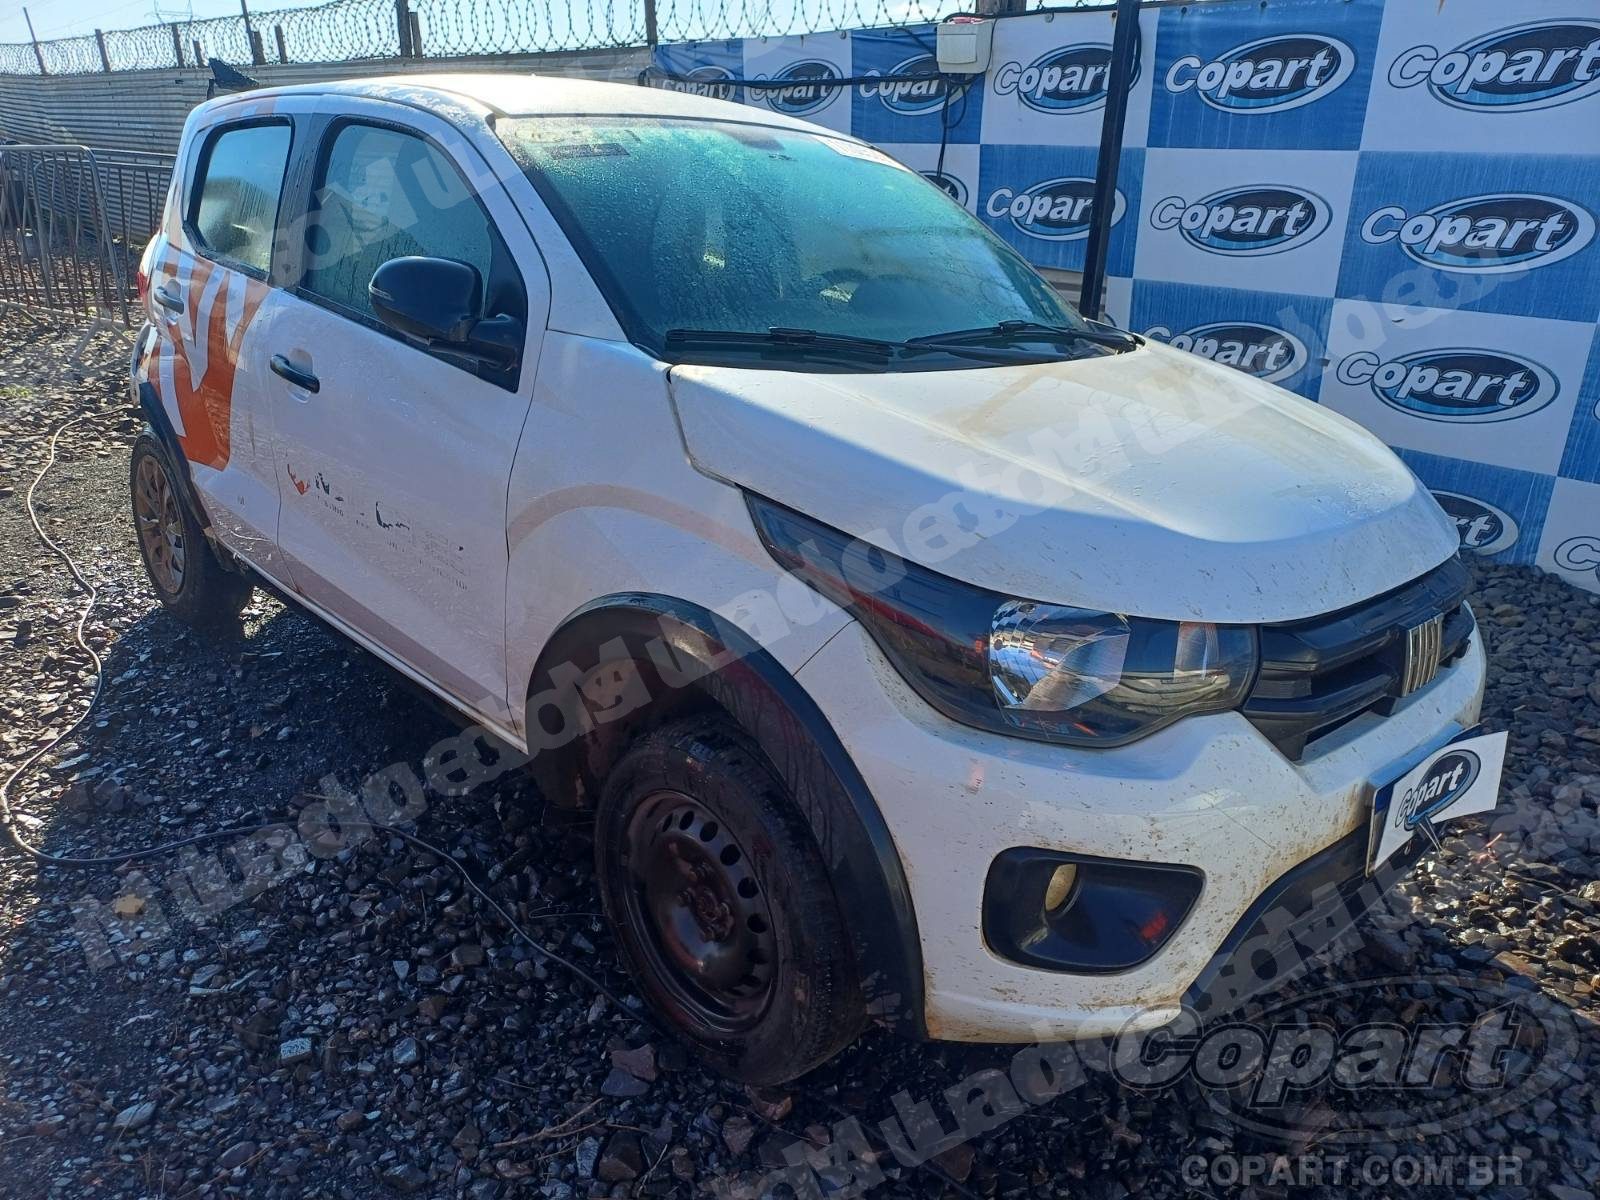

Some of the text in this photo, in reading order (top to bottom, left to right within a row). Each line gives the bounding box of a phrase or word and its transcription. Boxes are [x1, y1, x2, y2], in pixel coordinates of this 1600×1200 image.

[859, 69, 942, 103] Copar
[1165, 46, 1336, 98] Copart
[1388, 39, 1600, 94] Copart
[986, 187, 1096, 225] Copar
[1150, 196, 1308, 238] Copart
[1361, 206, 1569, 254] Copart
[1337, 351, 1531, 406] Copart
[1395, 761, 1464, 828] Copart
